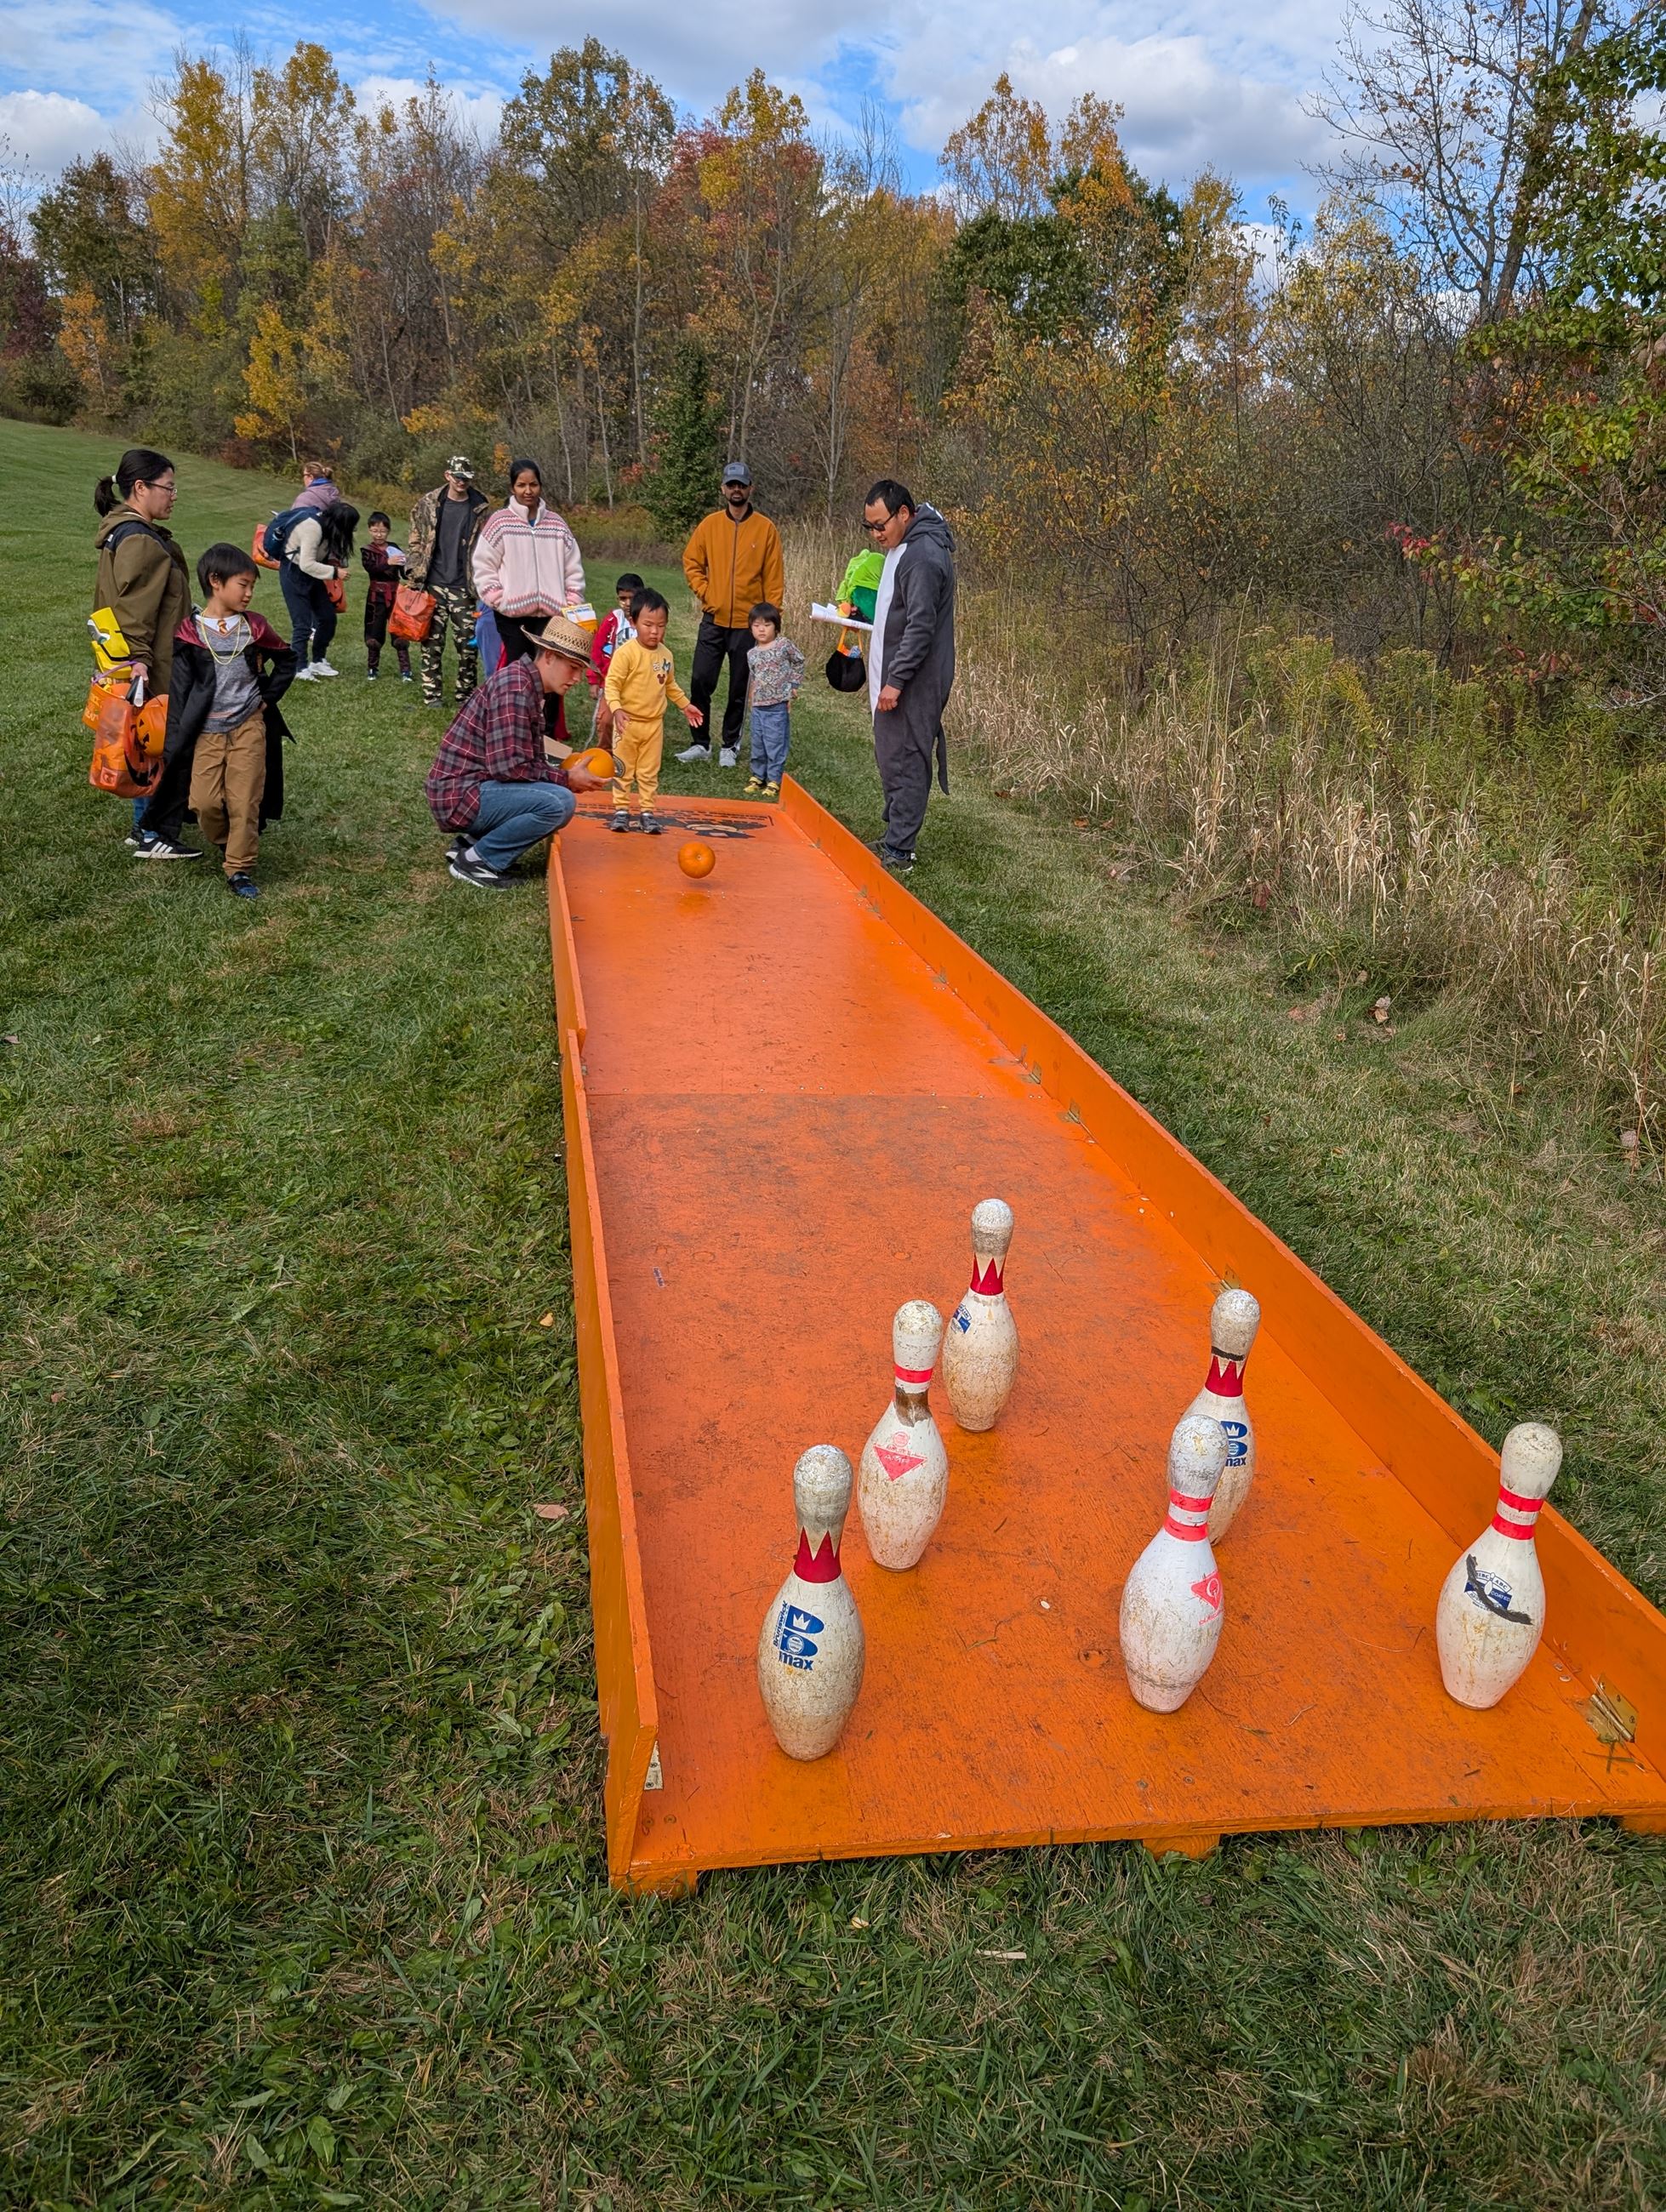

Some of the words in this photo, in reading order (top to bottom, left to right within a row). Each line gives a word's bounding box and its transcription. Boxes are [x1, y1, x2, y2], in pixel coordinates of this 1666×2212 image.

[1495, 1579, 1508, 1590] ABC
[1491, 1590, 1510, 1602] COATED
[773, 1600, 788, 1647] Brunswick
[779, 1651, 814, 1671] max
